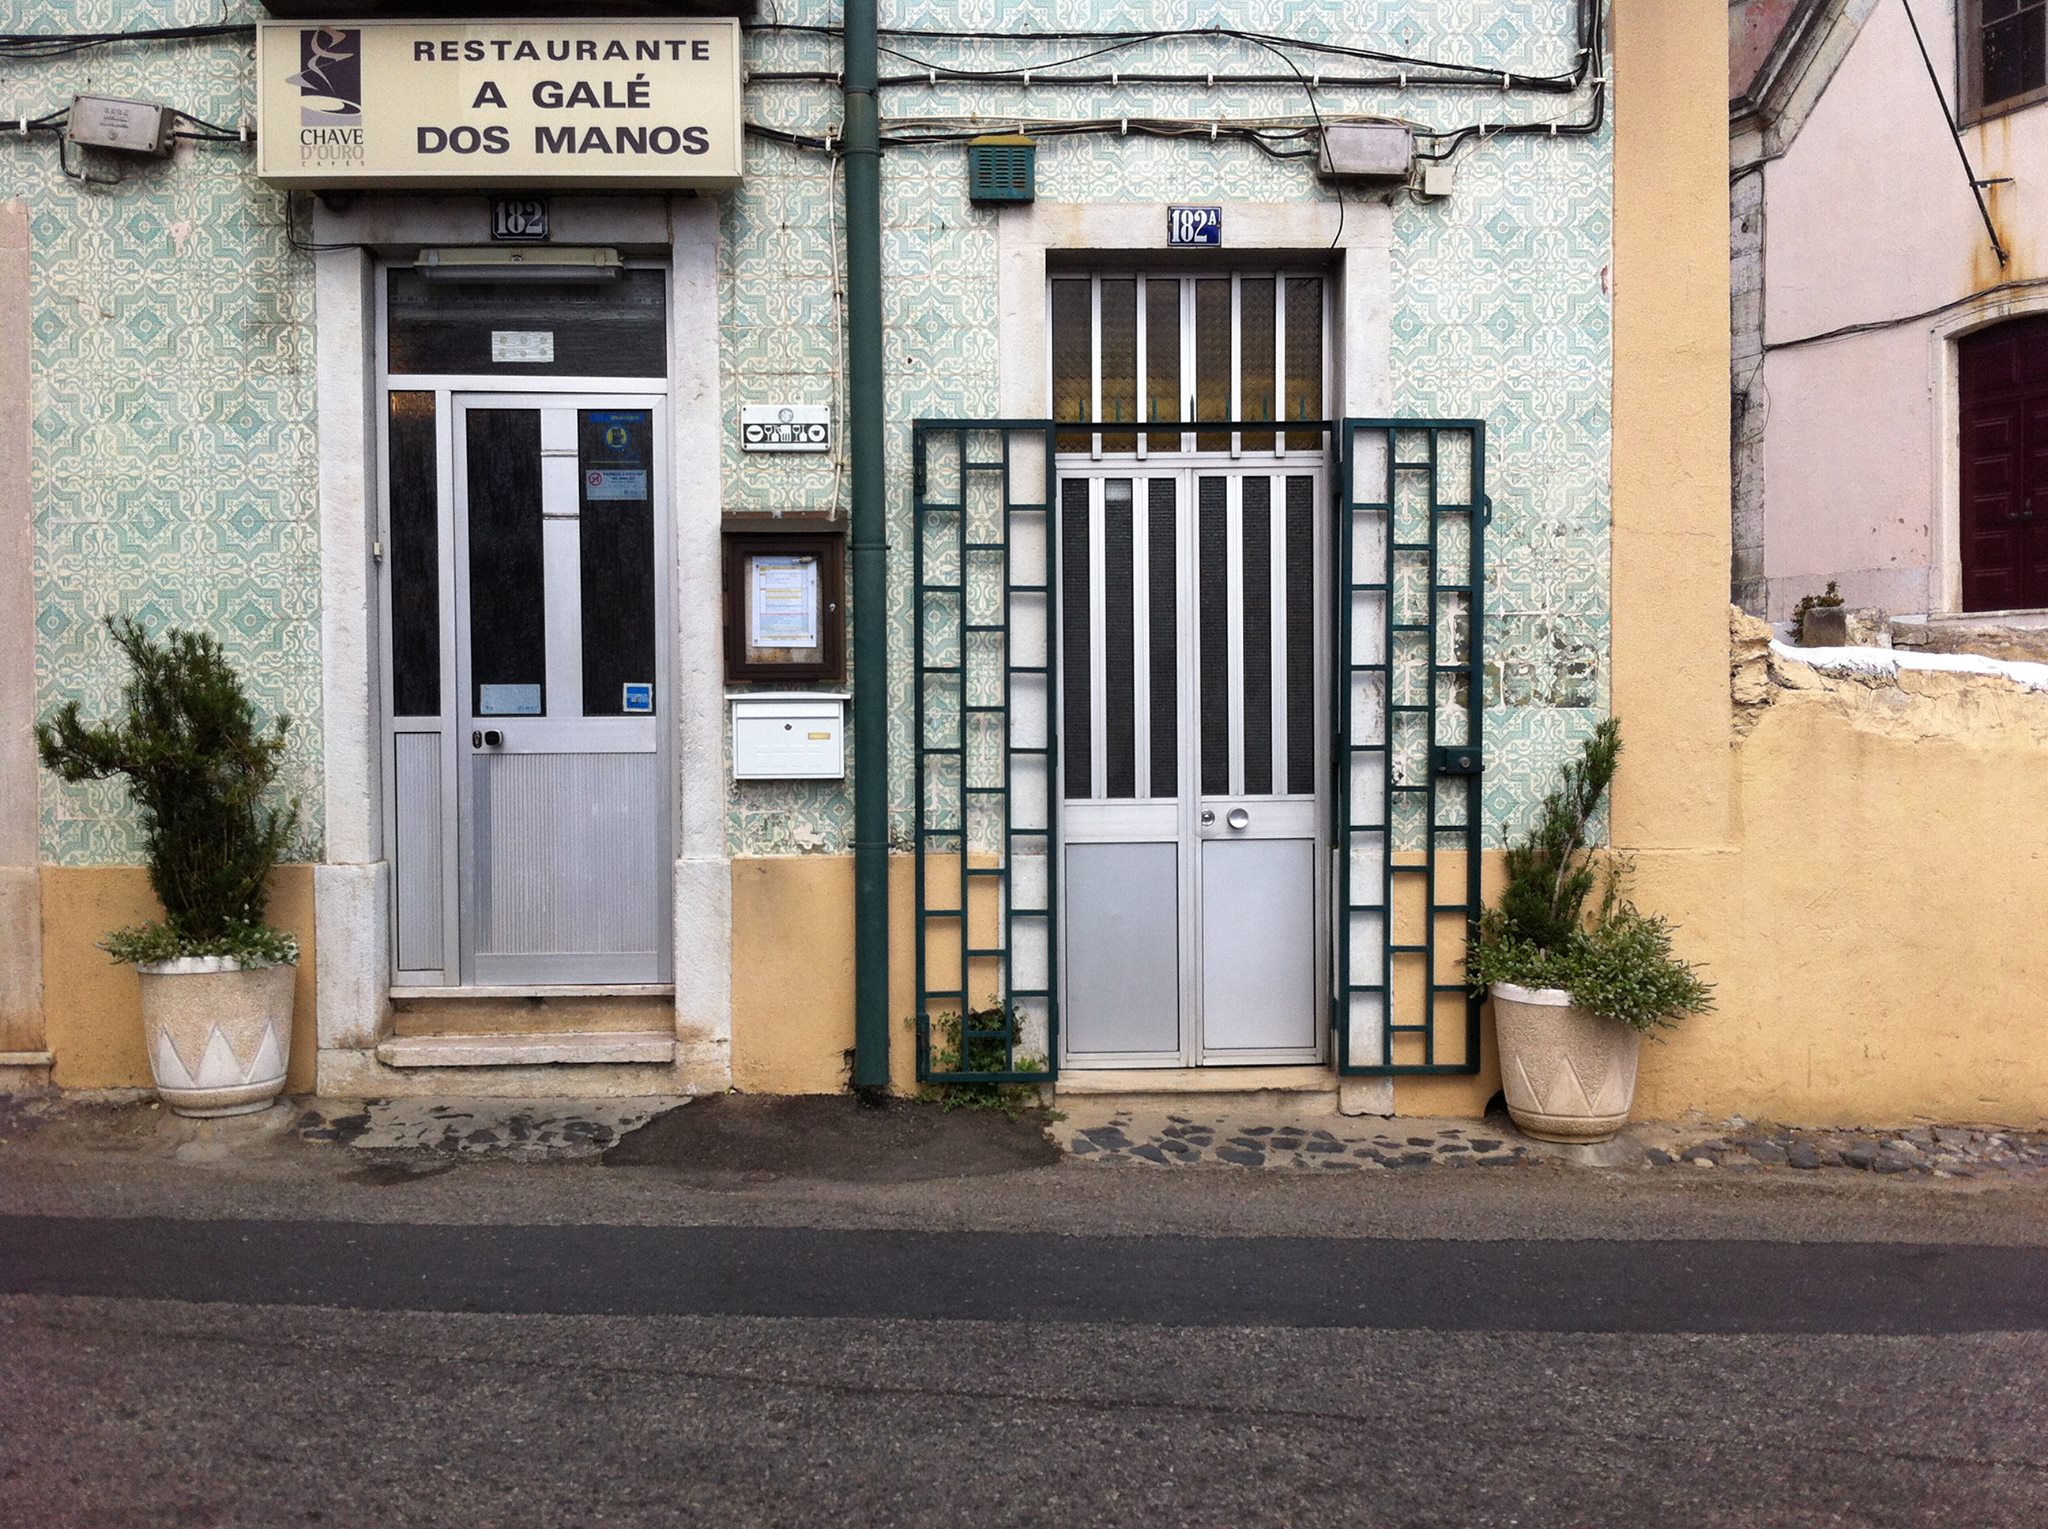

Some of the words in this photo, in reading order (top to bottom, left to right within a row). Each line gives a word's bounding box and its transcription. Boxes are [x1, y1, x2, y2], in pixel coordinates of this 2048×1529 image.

[413, 40, 710, 62] RESTAURANTE
[471, 81, 508, 109] A
[531, 73, 651, 109] GALÉ
[300, 128, 364, 146] CHAVE
[416, 126, 510, 155] DOS
[534, 126, 710, 156] MANOS
[300, 145, 364, 160] D'OURO
[496, 201, 543, 234] 182
